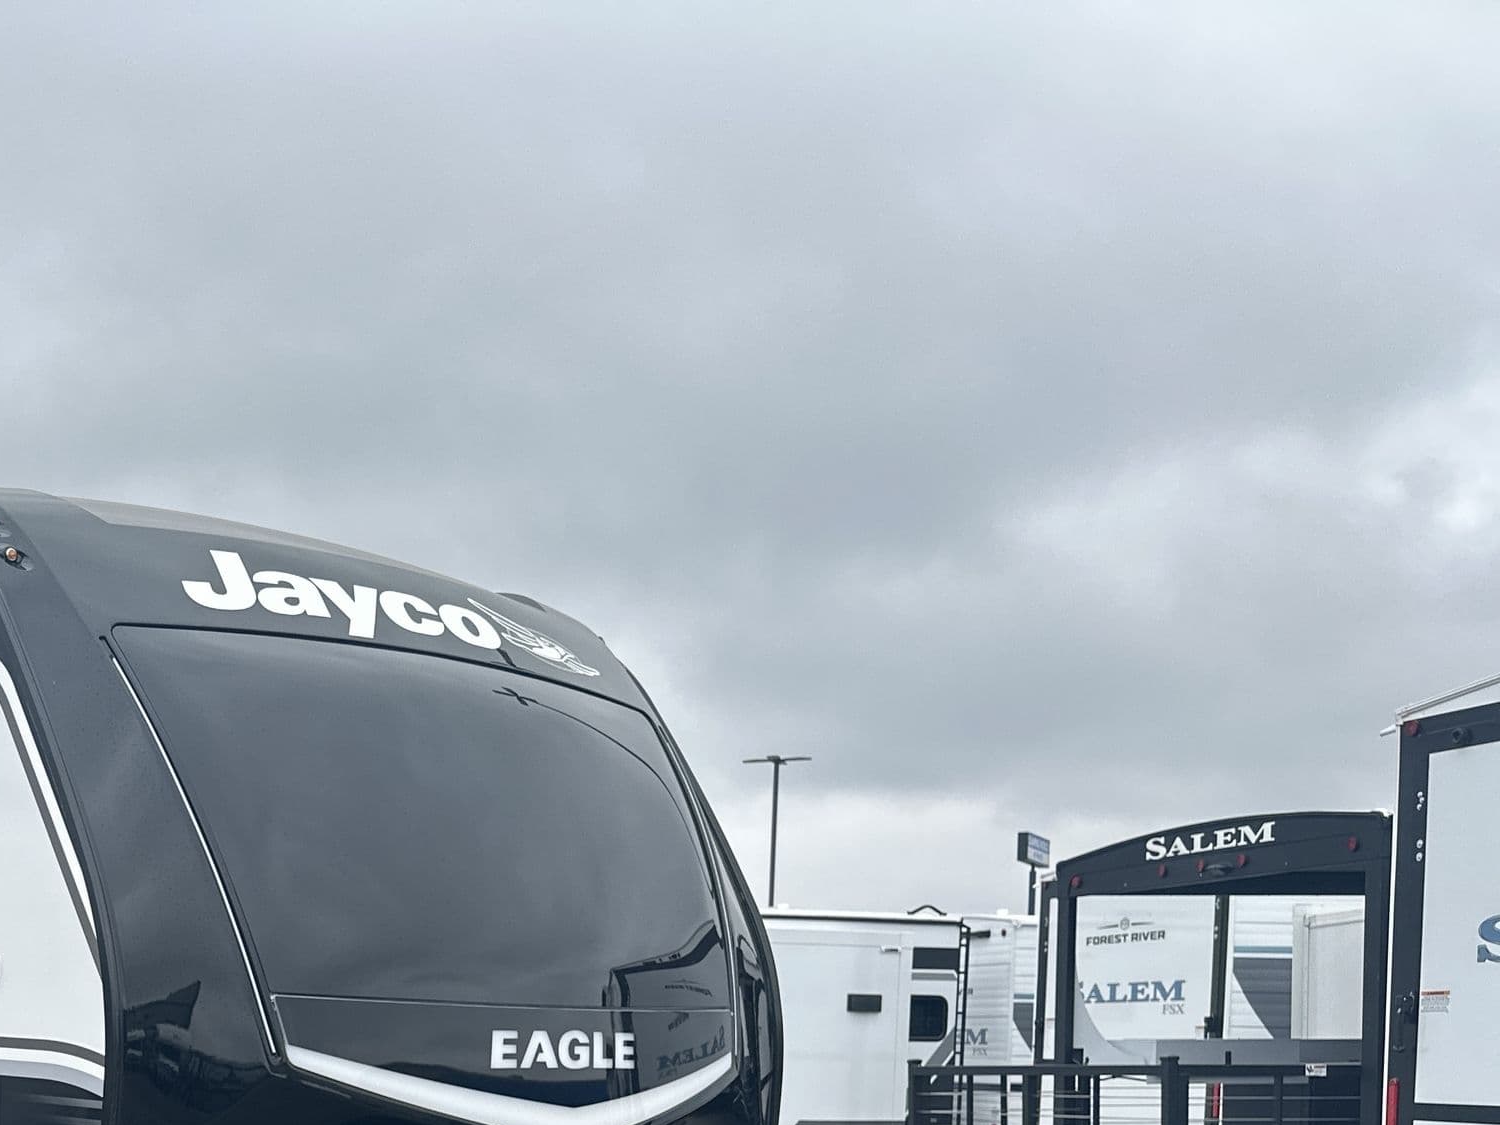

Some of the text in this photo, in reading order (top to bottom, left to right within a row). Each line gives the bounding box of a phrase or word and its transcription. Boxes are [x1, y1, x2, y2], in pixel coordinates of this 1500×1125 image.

[181, 549, 501, 650] Jayco
[1145, 821, 1276, 861] SALEM
[1086, 930, 1166, 946] FOREST RIVER
[1162, 1004, 1185, 1015] FSX
[490, 1030, 635, 1069] EAGLE
